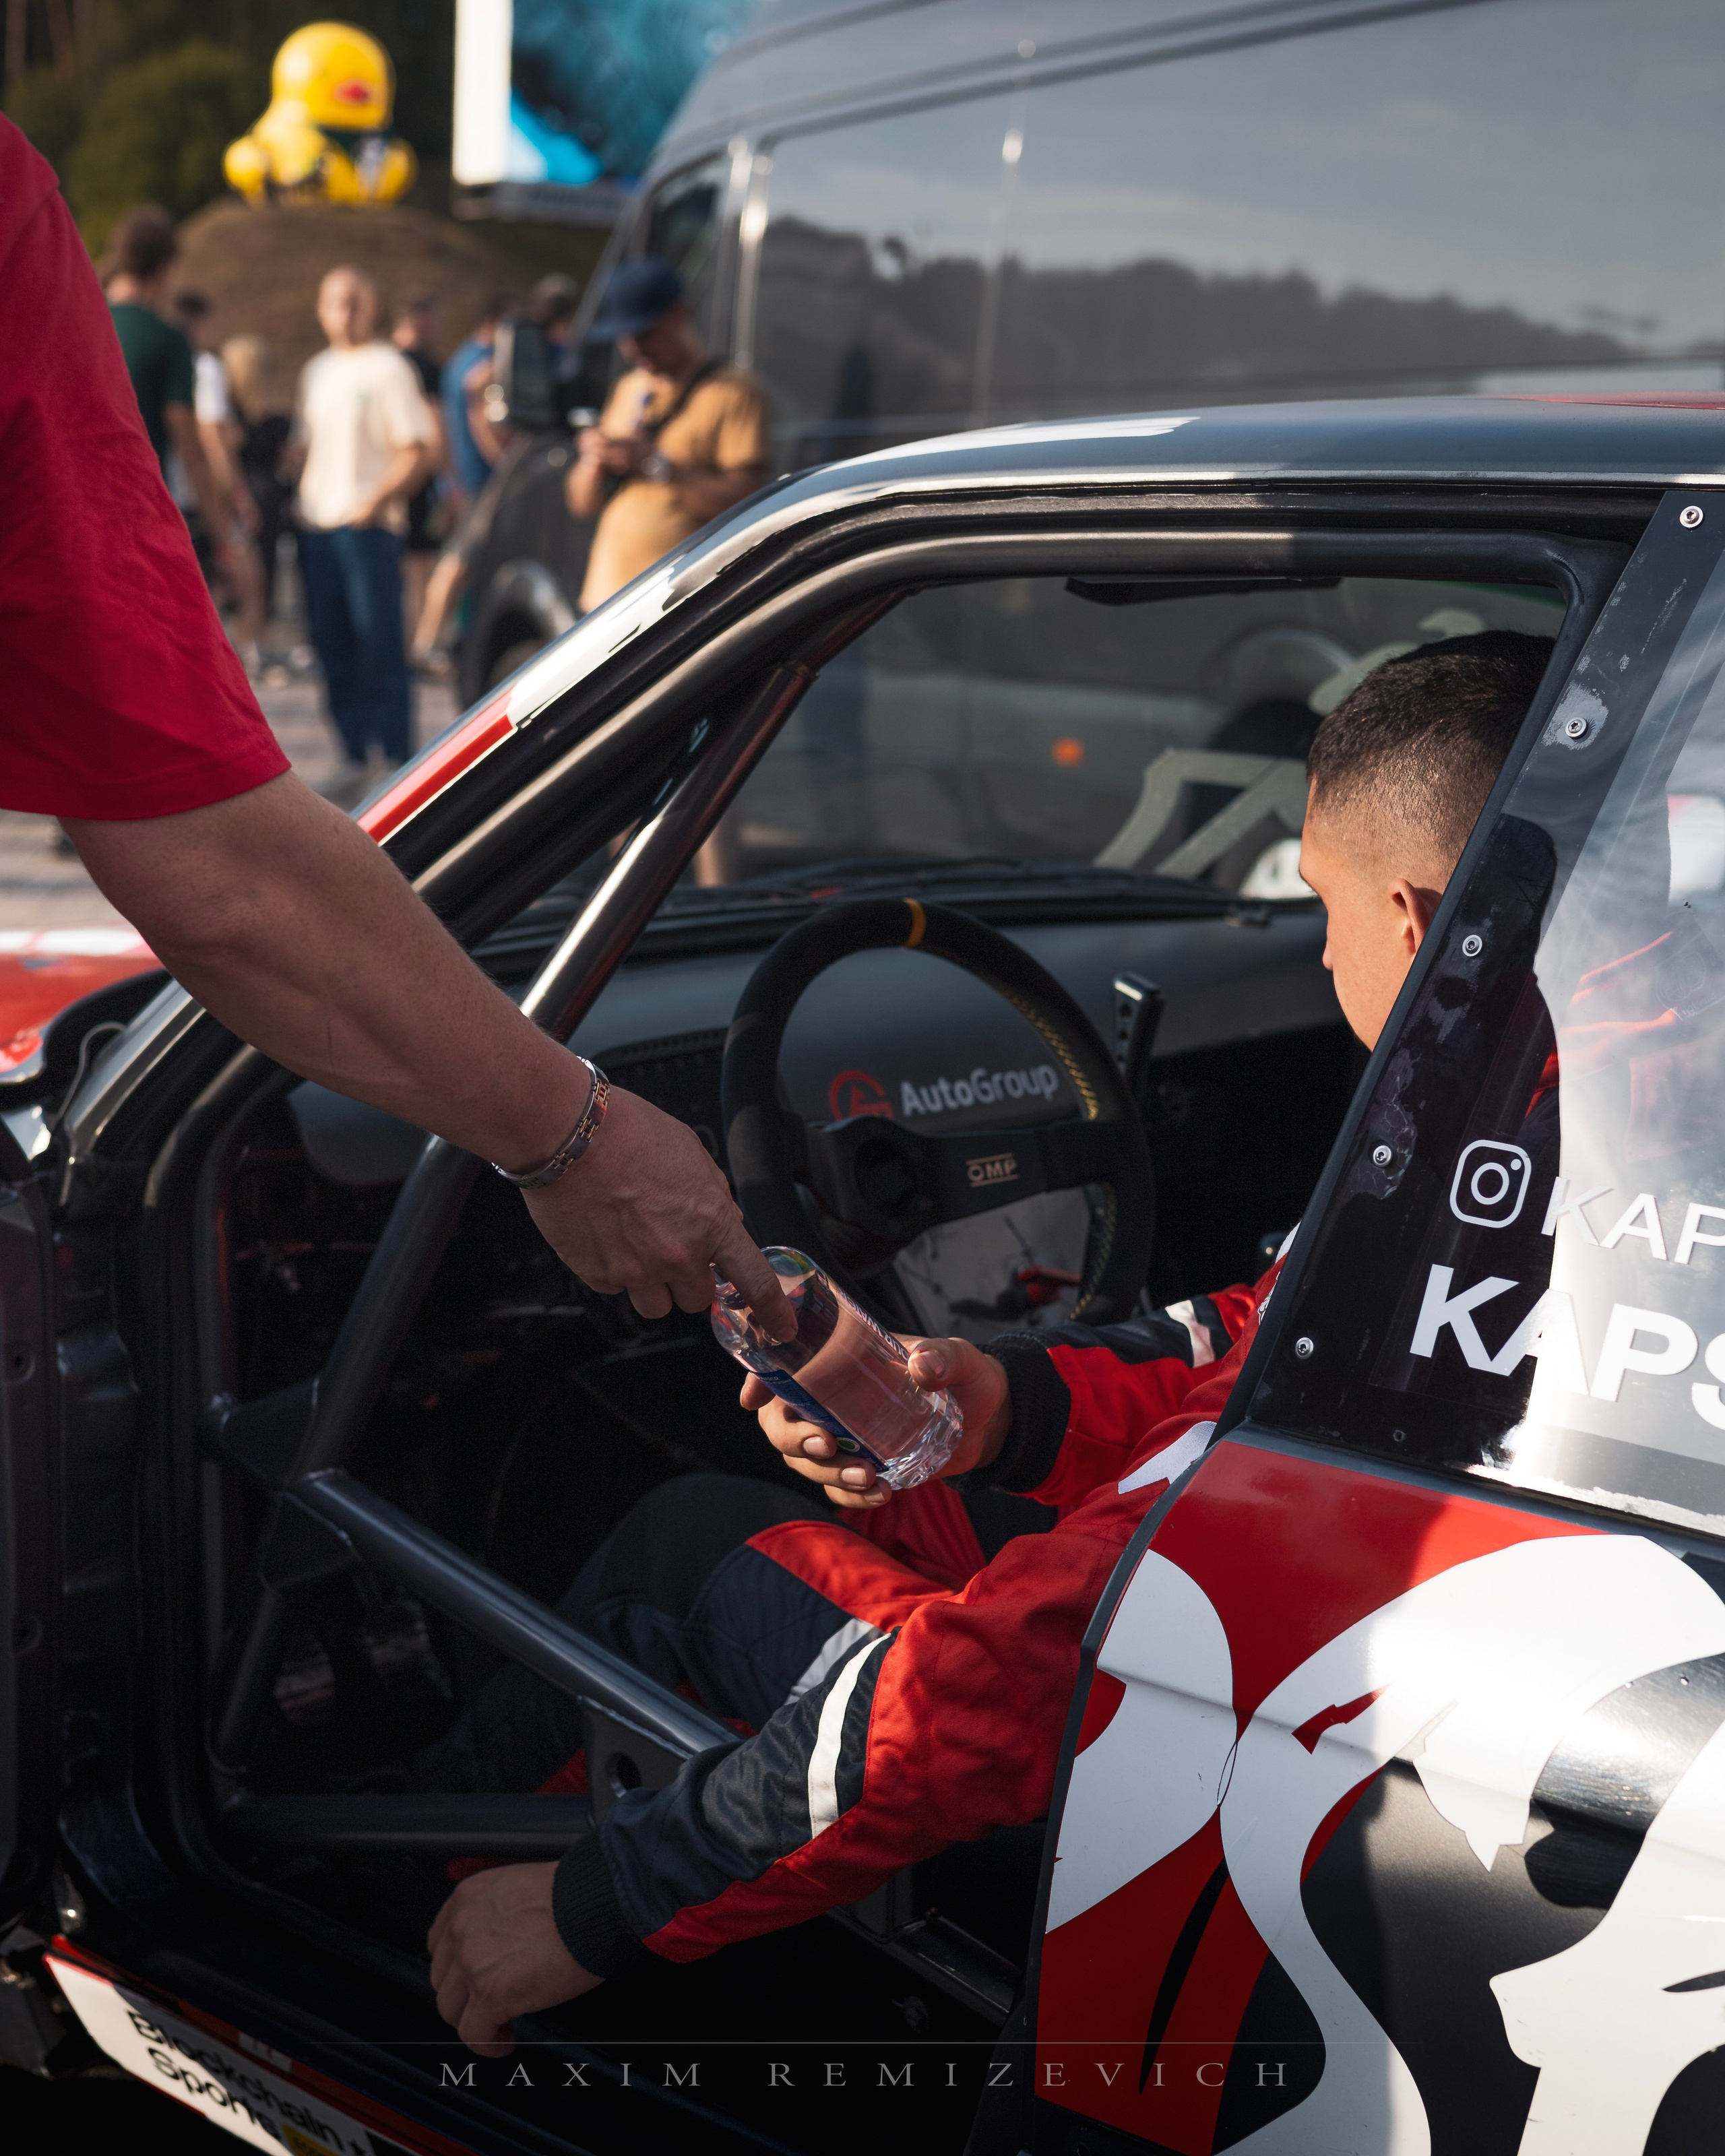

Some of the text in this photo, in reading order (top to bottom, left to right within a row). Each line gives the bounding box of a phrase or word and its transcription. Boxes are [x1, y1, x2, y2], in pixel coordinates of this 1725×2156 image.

[900, 1064, 1059, 1118] AutoGroup
[966, 1157, 1018, 1182] OMP
[840, 1290, 882, 1337] WATER
[127, 2010, 347, 2152] Blockchain
[148, 2046, 281, 2141] Sports
